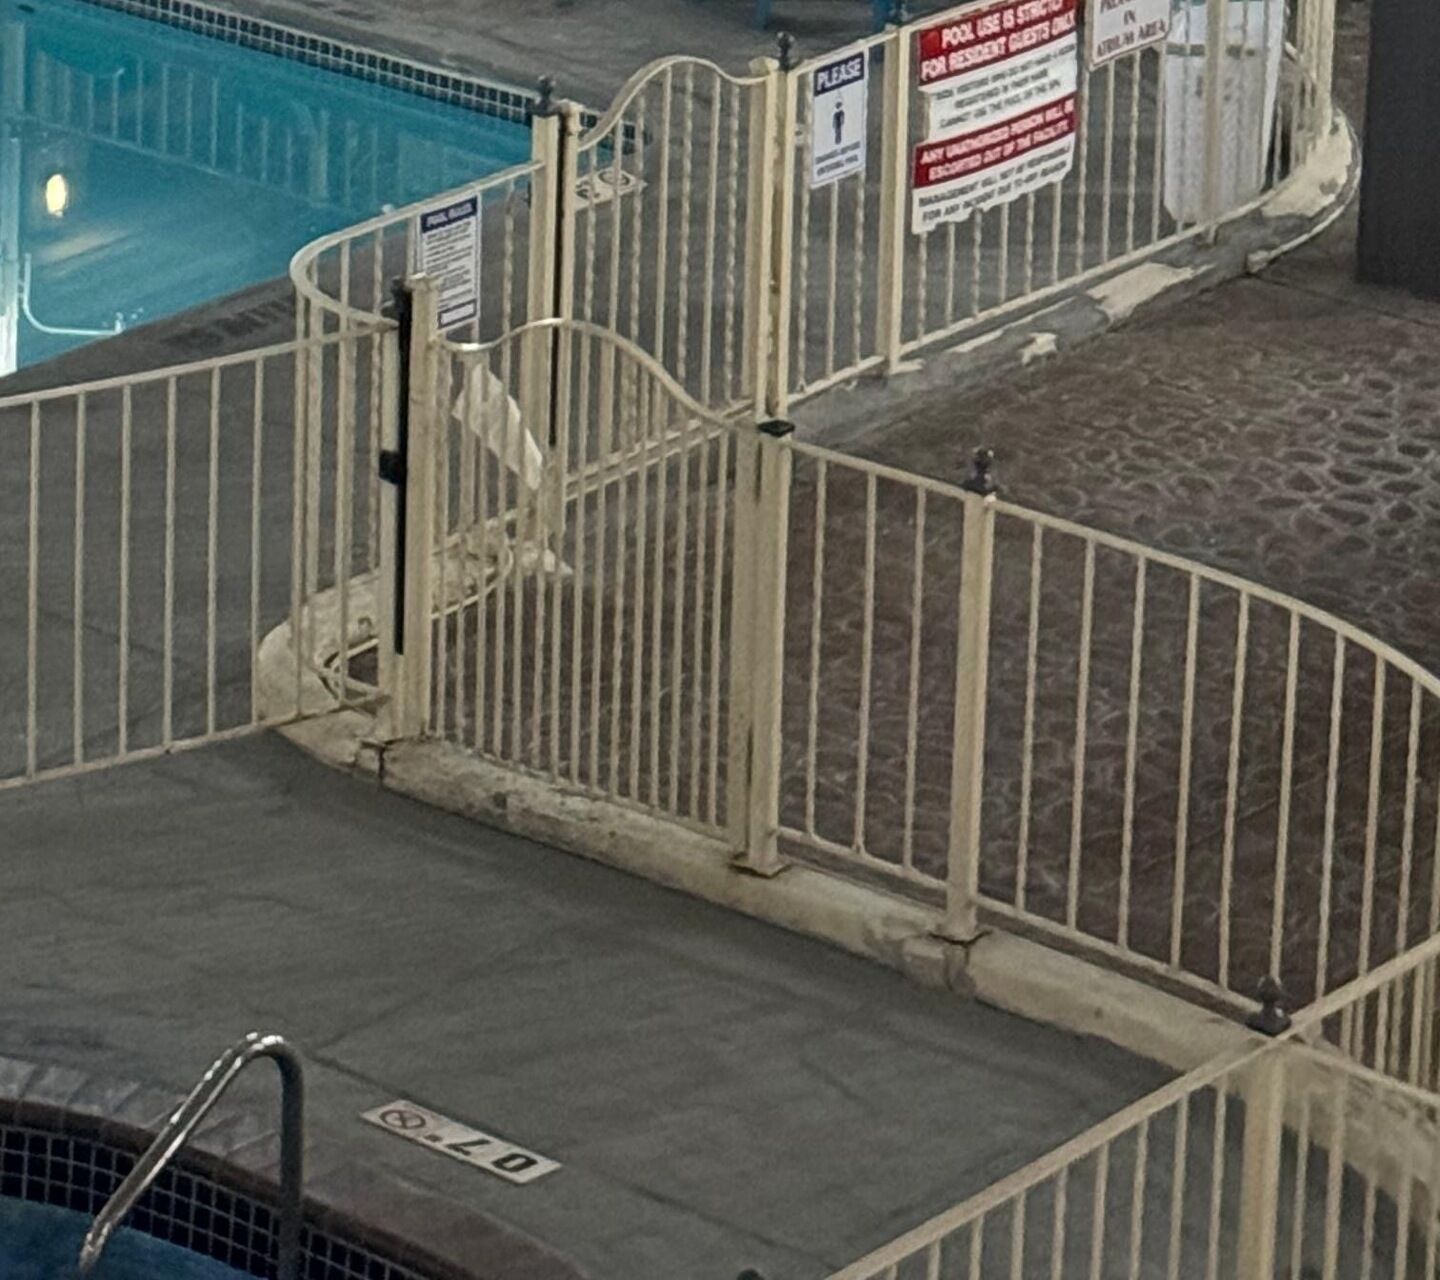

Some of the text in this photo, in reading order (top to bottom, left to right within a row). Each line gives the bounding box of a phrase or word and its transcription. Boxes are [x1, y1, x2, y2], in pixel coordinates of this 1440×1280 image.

[942, 22, 975, 49] POOL
[976, 12, 1001, 38] USE
[1003, 8, 1015, 30] IS
[921, 55, 948, 81] FOR
[949, 36, 1007, 72] RESIDENT
[1009, 20, 1051, 52] GUESTS
[817, 57, 862, 91] PLEASE
[920, 146, 946, 166] ANY
